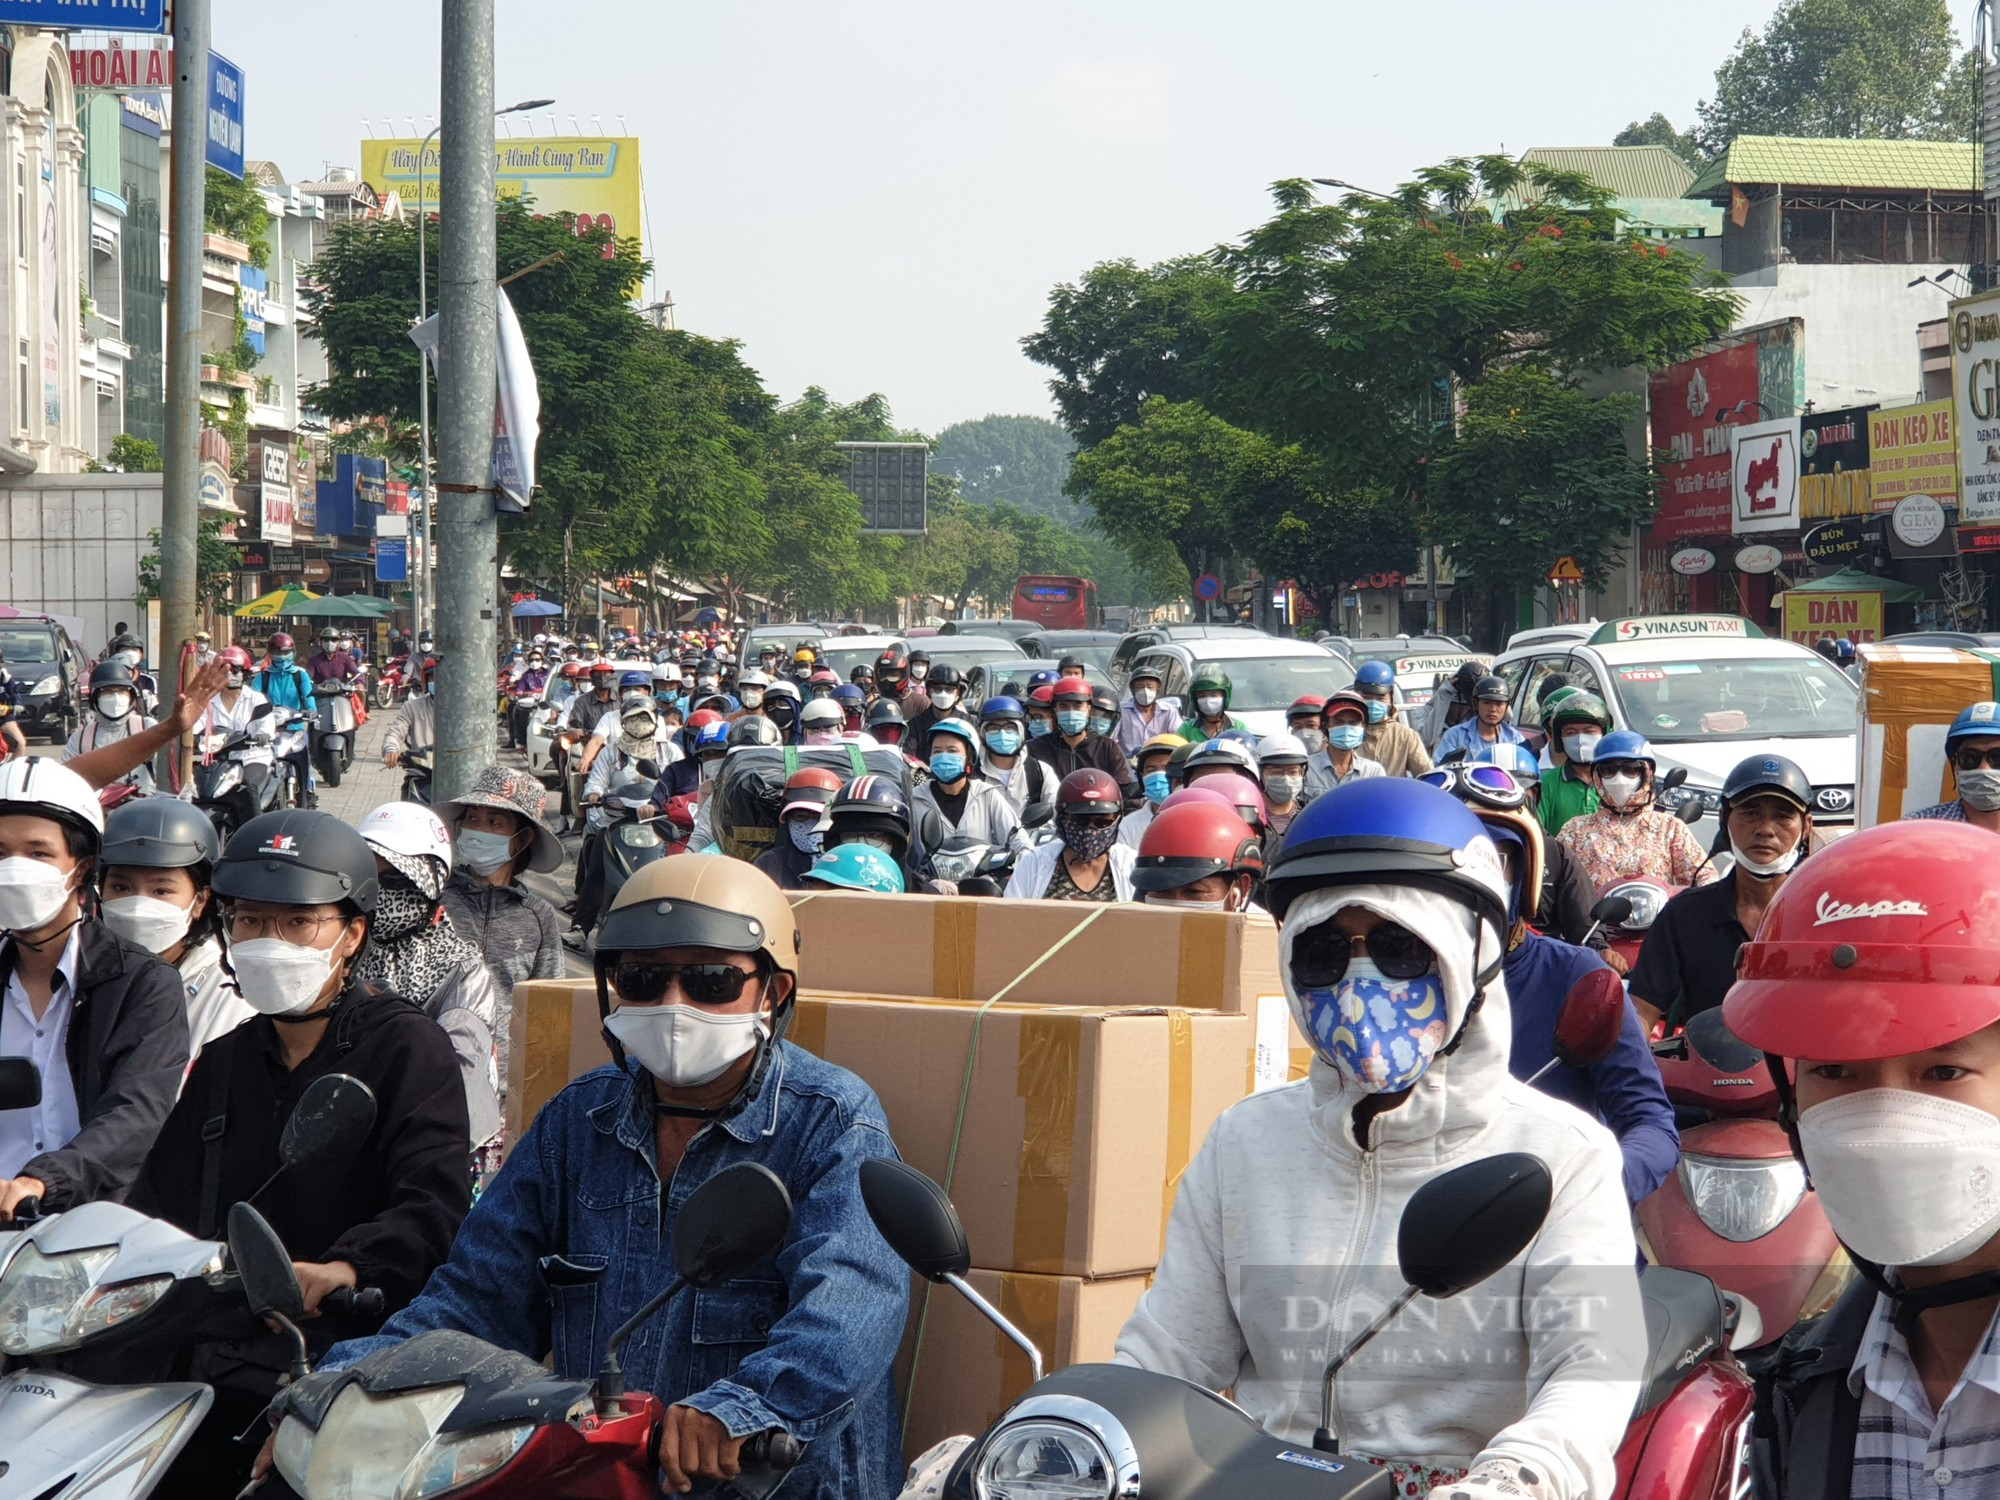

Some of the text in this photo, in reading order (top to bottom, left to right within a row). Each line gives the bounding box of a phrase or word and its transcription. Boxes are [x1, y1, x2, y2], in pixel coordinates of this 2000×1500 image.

[70, 38, 139, 87] HOÀI
[543, 147, 576, 173] Cùng
[577, 147, 606, 170] Bạn
[1873, 411, 1950, 450] DÁN KEO XE
[1901, 514, 1938, 528] GEM
[1820, 528, 1845, 542] BÚN
[1810, 544, 1835, 558] ĐẬU
[1808, 596, 1859, 625] DÁN
[1813, 891, 1928, 927] Vespa
[1712, 1078, 1755, 1087] HONDA
[12, 1383, 57, 1400] ONDA
